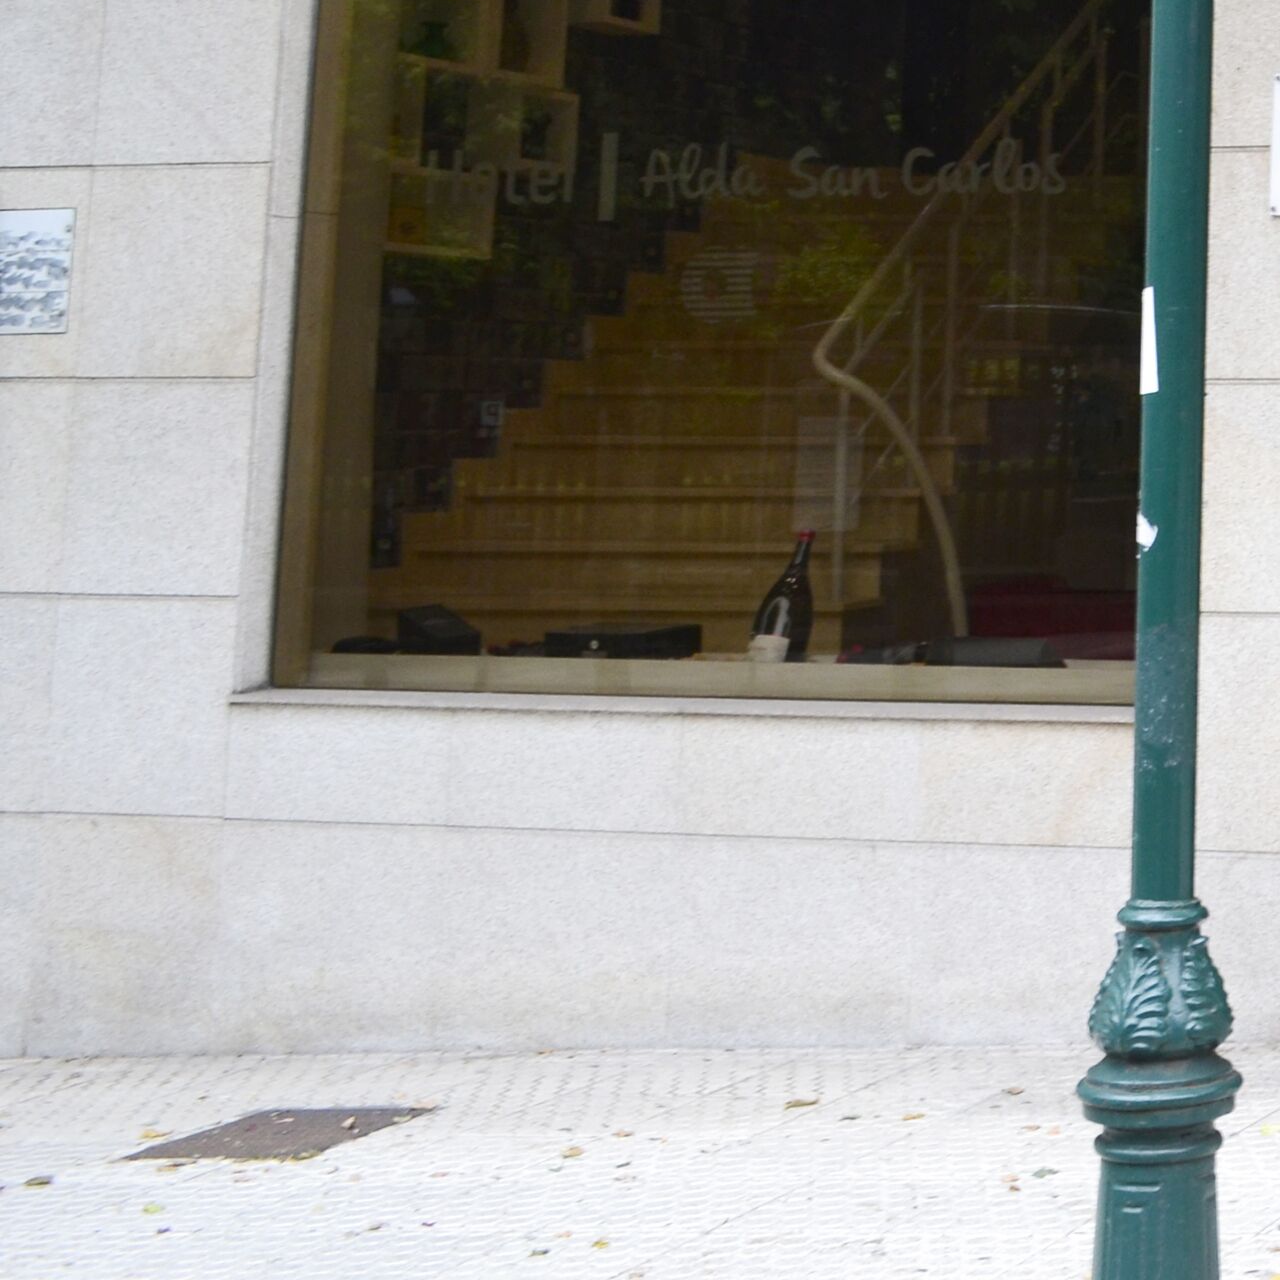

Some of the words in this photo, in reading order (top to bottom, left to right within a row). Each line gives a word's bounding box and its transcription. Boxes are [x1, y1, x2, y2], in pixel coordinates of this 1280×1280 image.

[427, 148, 574, 205] Hotel
[640, 141, 766, 209] Alda
[787, 145, 888, 200] San
[903, 137, 1067, 196] Carlos
